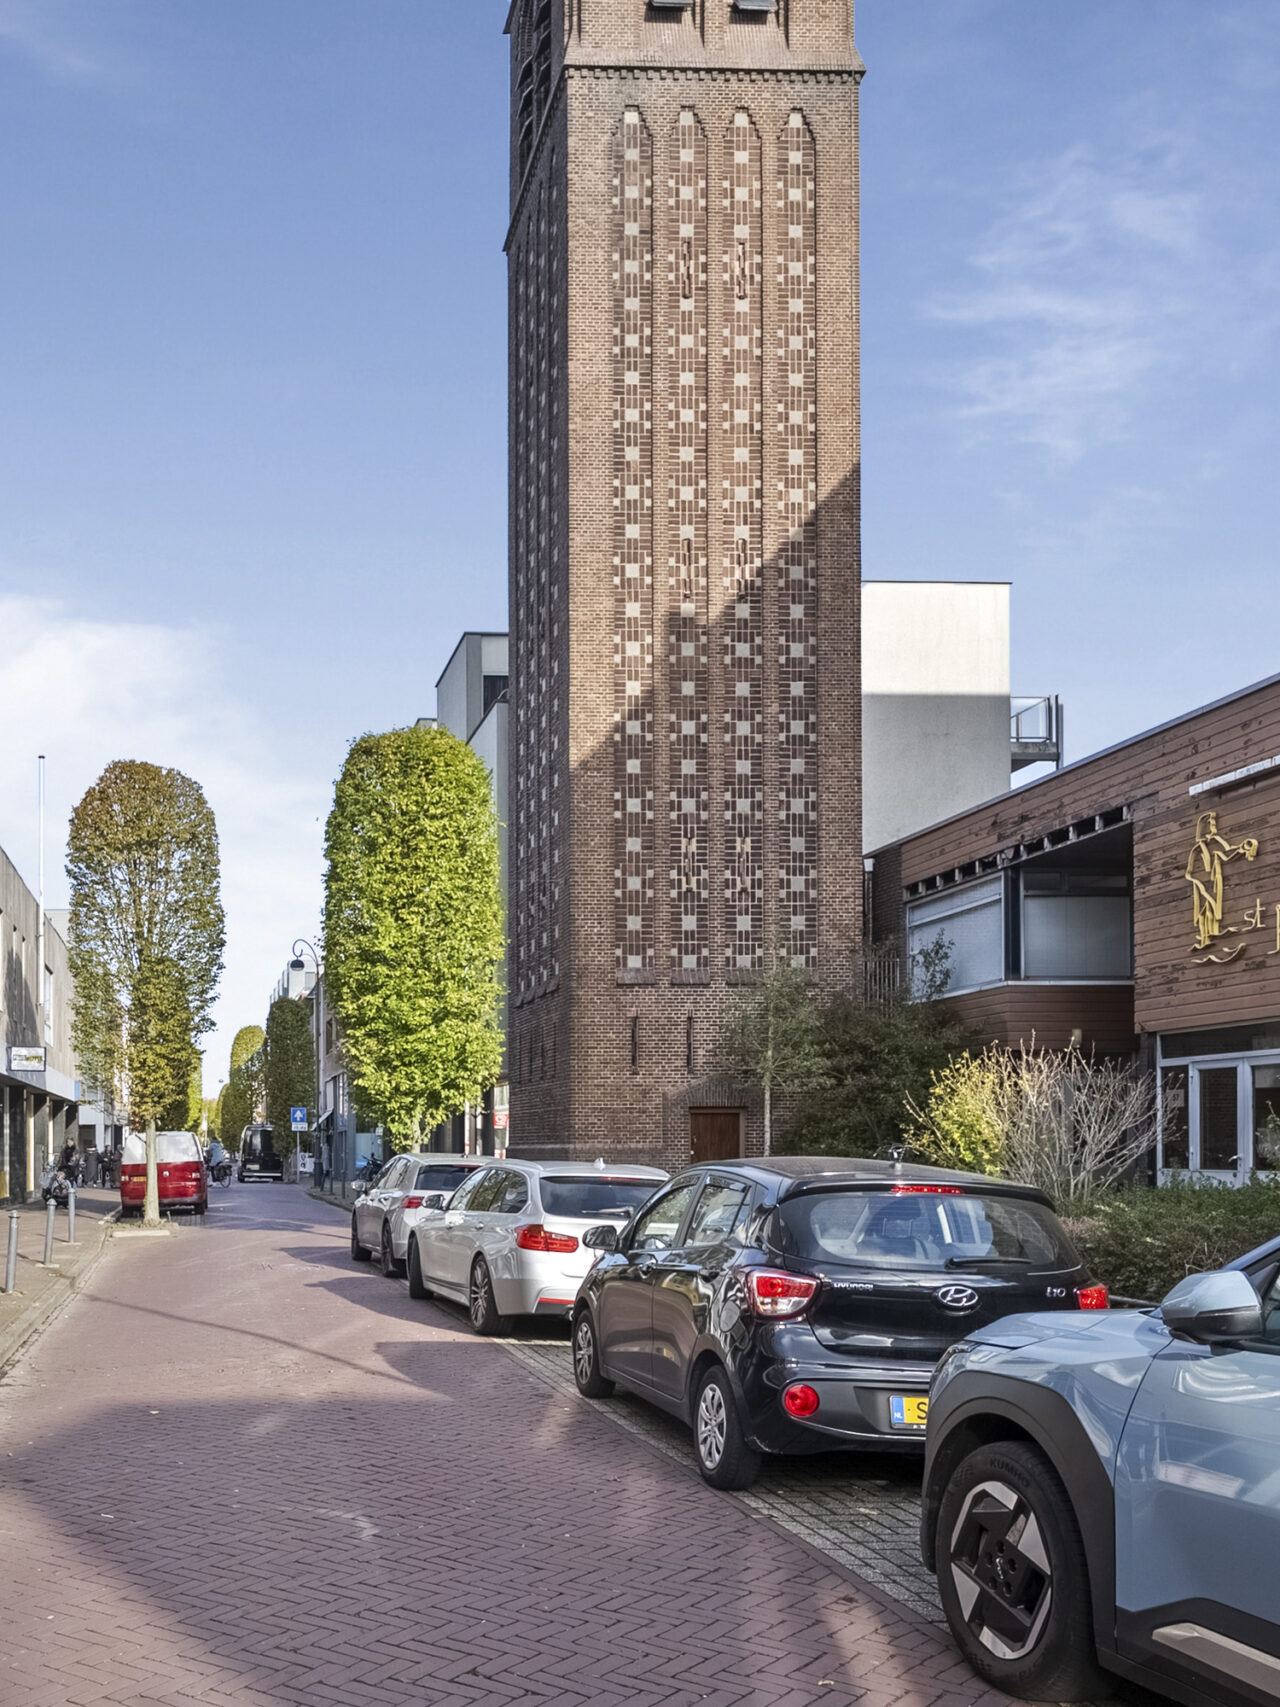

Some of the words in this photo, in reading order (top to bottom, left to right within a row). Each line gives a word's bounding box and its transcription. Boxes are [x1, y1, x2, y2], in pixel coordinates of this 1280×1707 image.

[1241, 898, 1266, 931] st
[833, 1281, 874, 1291] HYUNDAI
[893, 1411, 904, 1419] NL
[989, 1457, 1031, 1489] KUMHO
